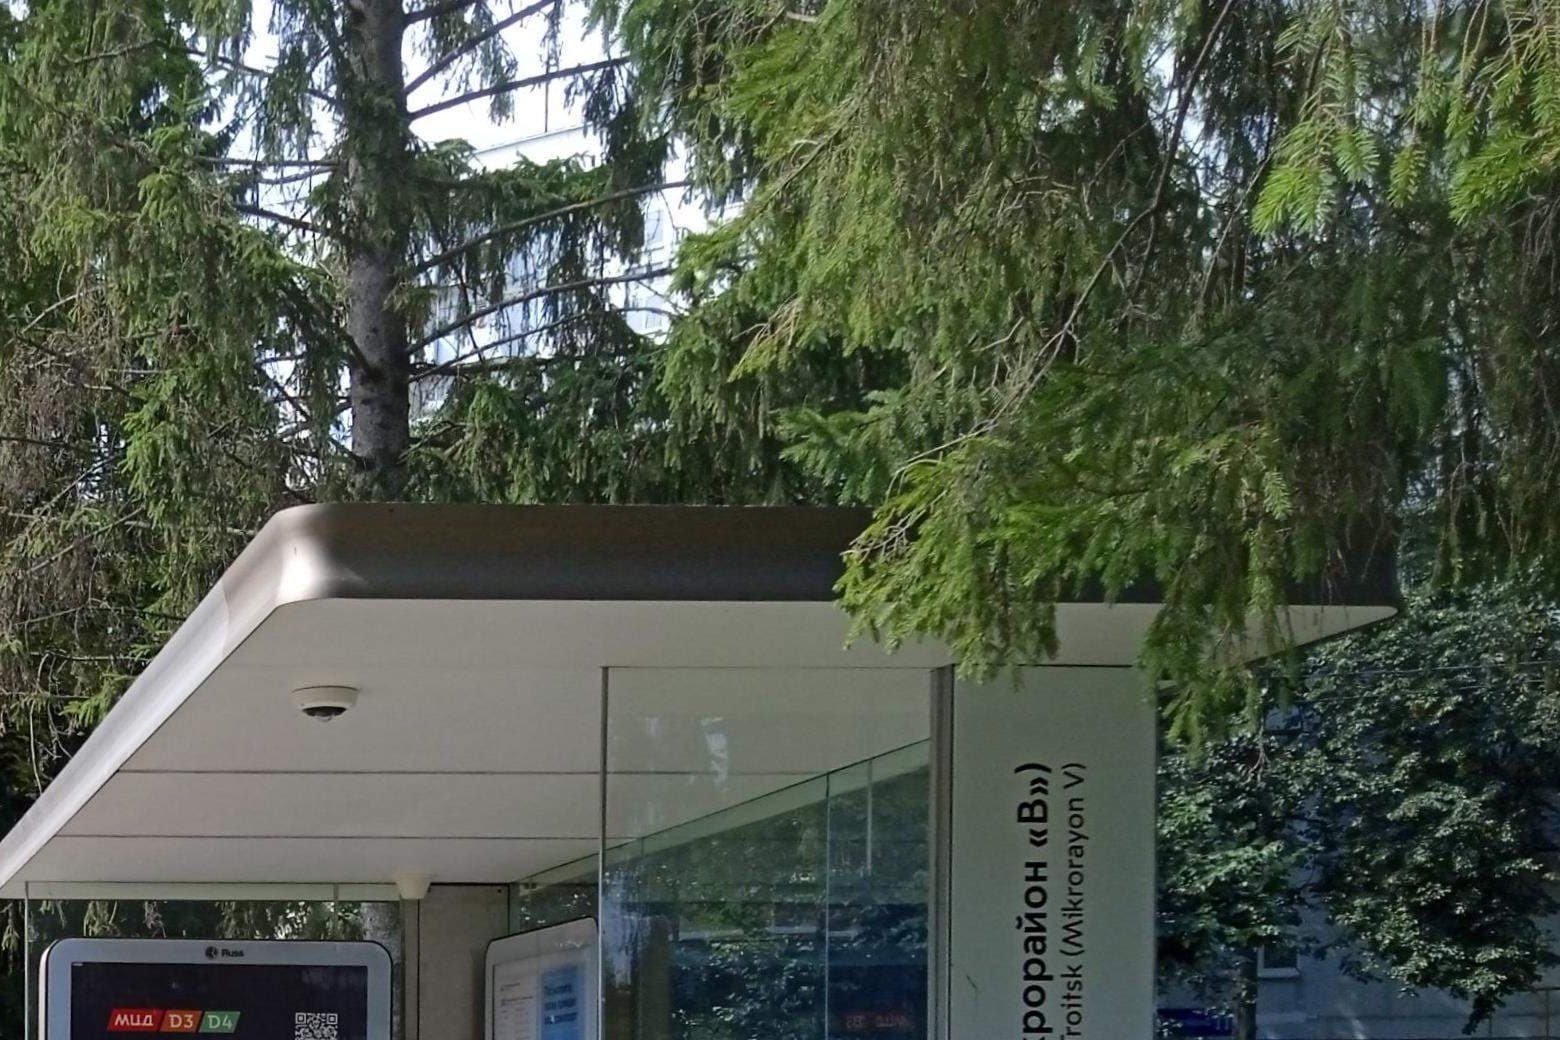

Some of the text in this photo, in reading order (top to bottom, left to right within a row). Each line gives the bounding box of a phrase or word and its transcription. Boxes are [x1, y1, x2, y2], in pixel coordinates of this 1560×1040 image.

[1061, 762, 1087, 790] V)
[1014, 763, 1052, 847] «В»)
[1059, 798, 1090, 957] (Mikrorayon
[114, 1013, 234, 1030] МЦД D3 D4
